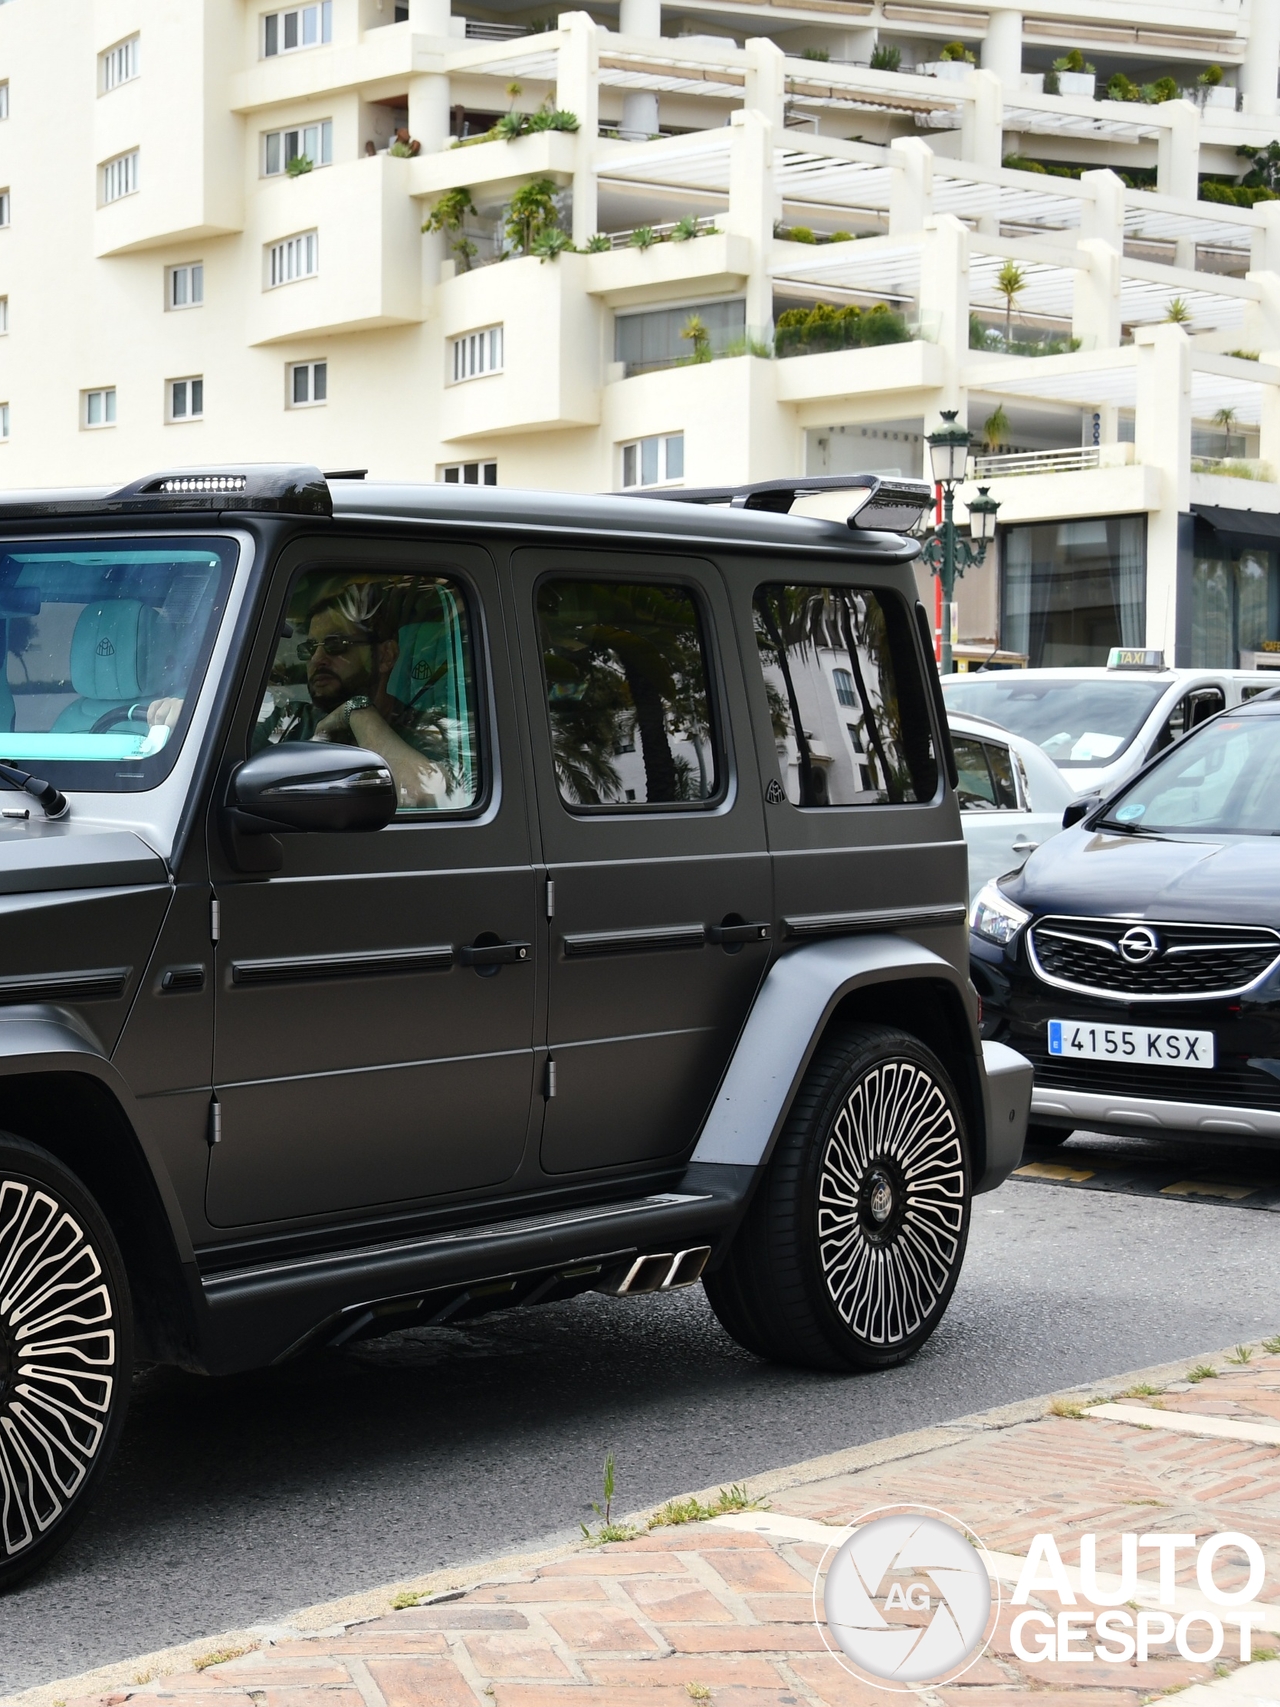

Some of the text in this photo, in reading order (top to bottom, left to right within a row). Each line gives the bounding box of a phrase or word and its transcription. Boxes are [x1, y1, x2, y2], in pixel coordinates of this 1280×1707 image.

[1120, 651, 1145, 665] TAXI
[1053, 1041, 1059, 1049] E
[1070, 1028, 1200, 1061] 4155 KSX
